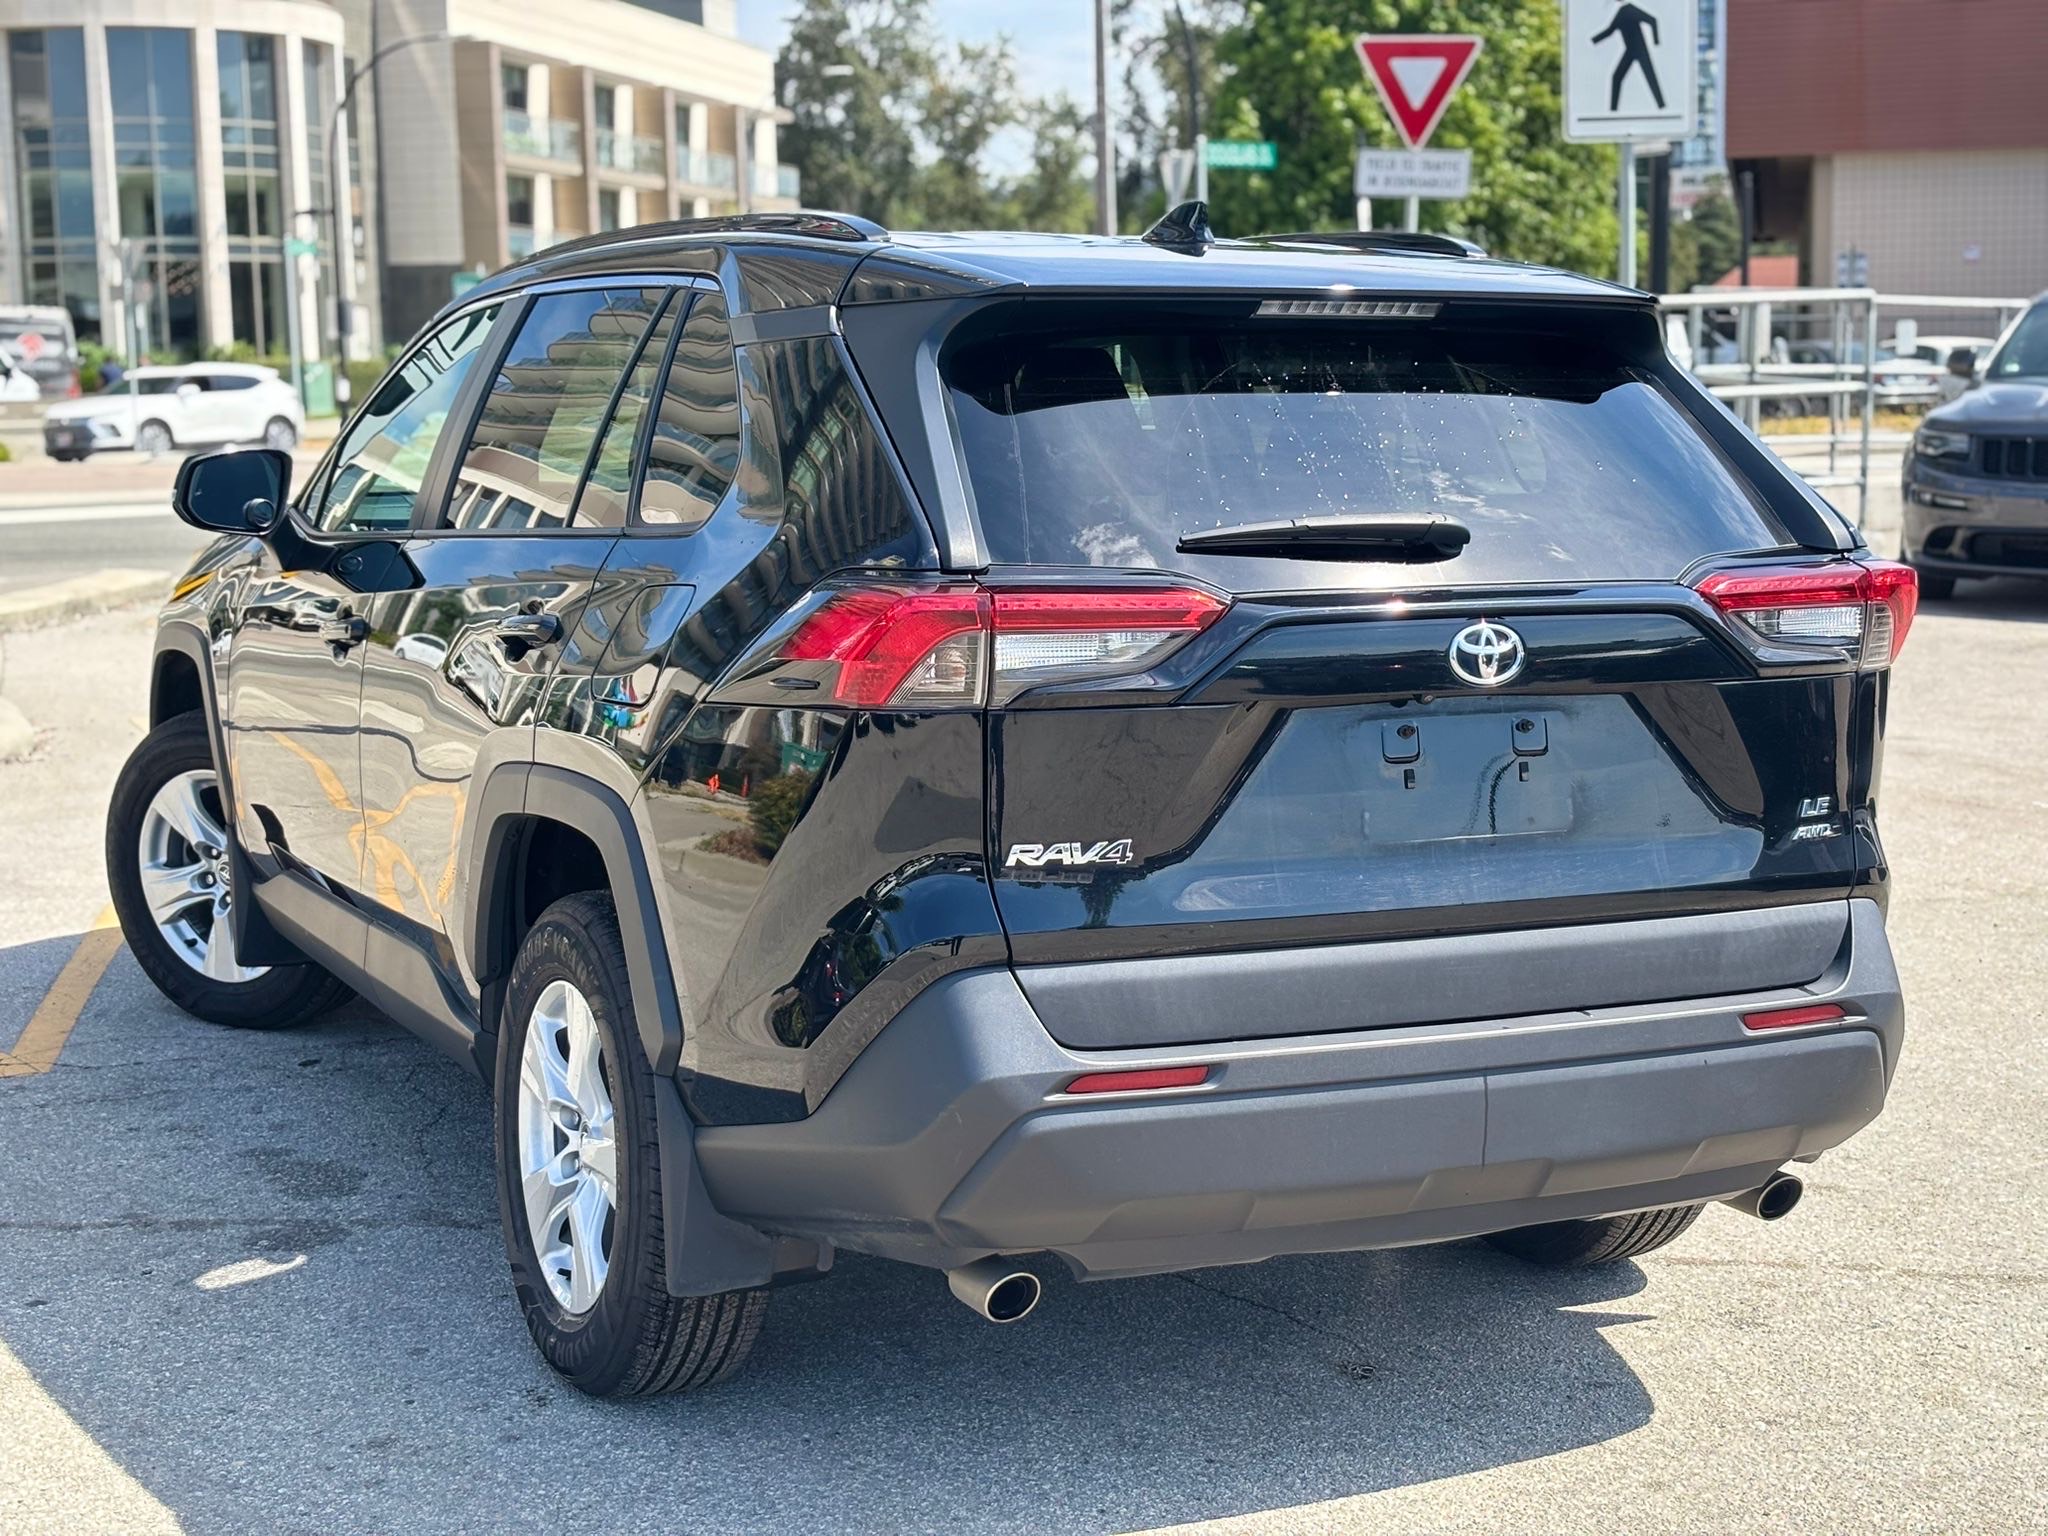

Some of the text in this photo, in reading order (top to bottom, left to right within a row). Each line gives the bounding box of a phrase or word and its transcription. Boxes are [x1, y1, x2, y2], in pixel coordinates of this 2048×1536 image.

[1800, 797, 1830, 817] LE
[1792, 823, 1841, 840] AWD
[1004, 838, 1133, 866] RAV4
